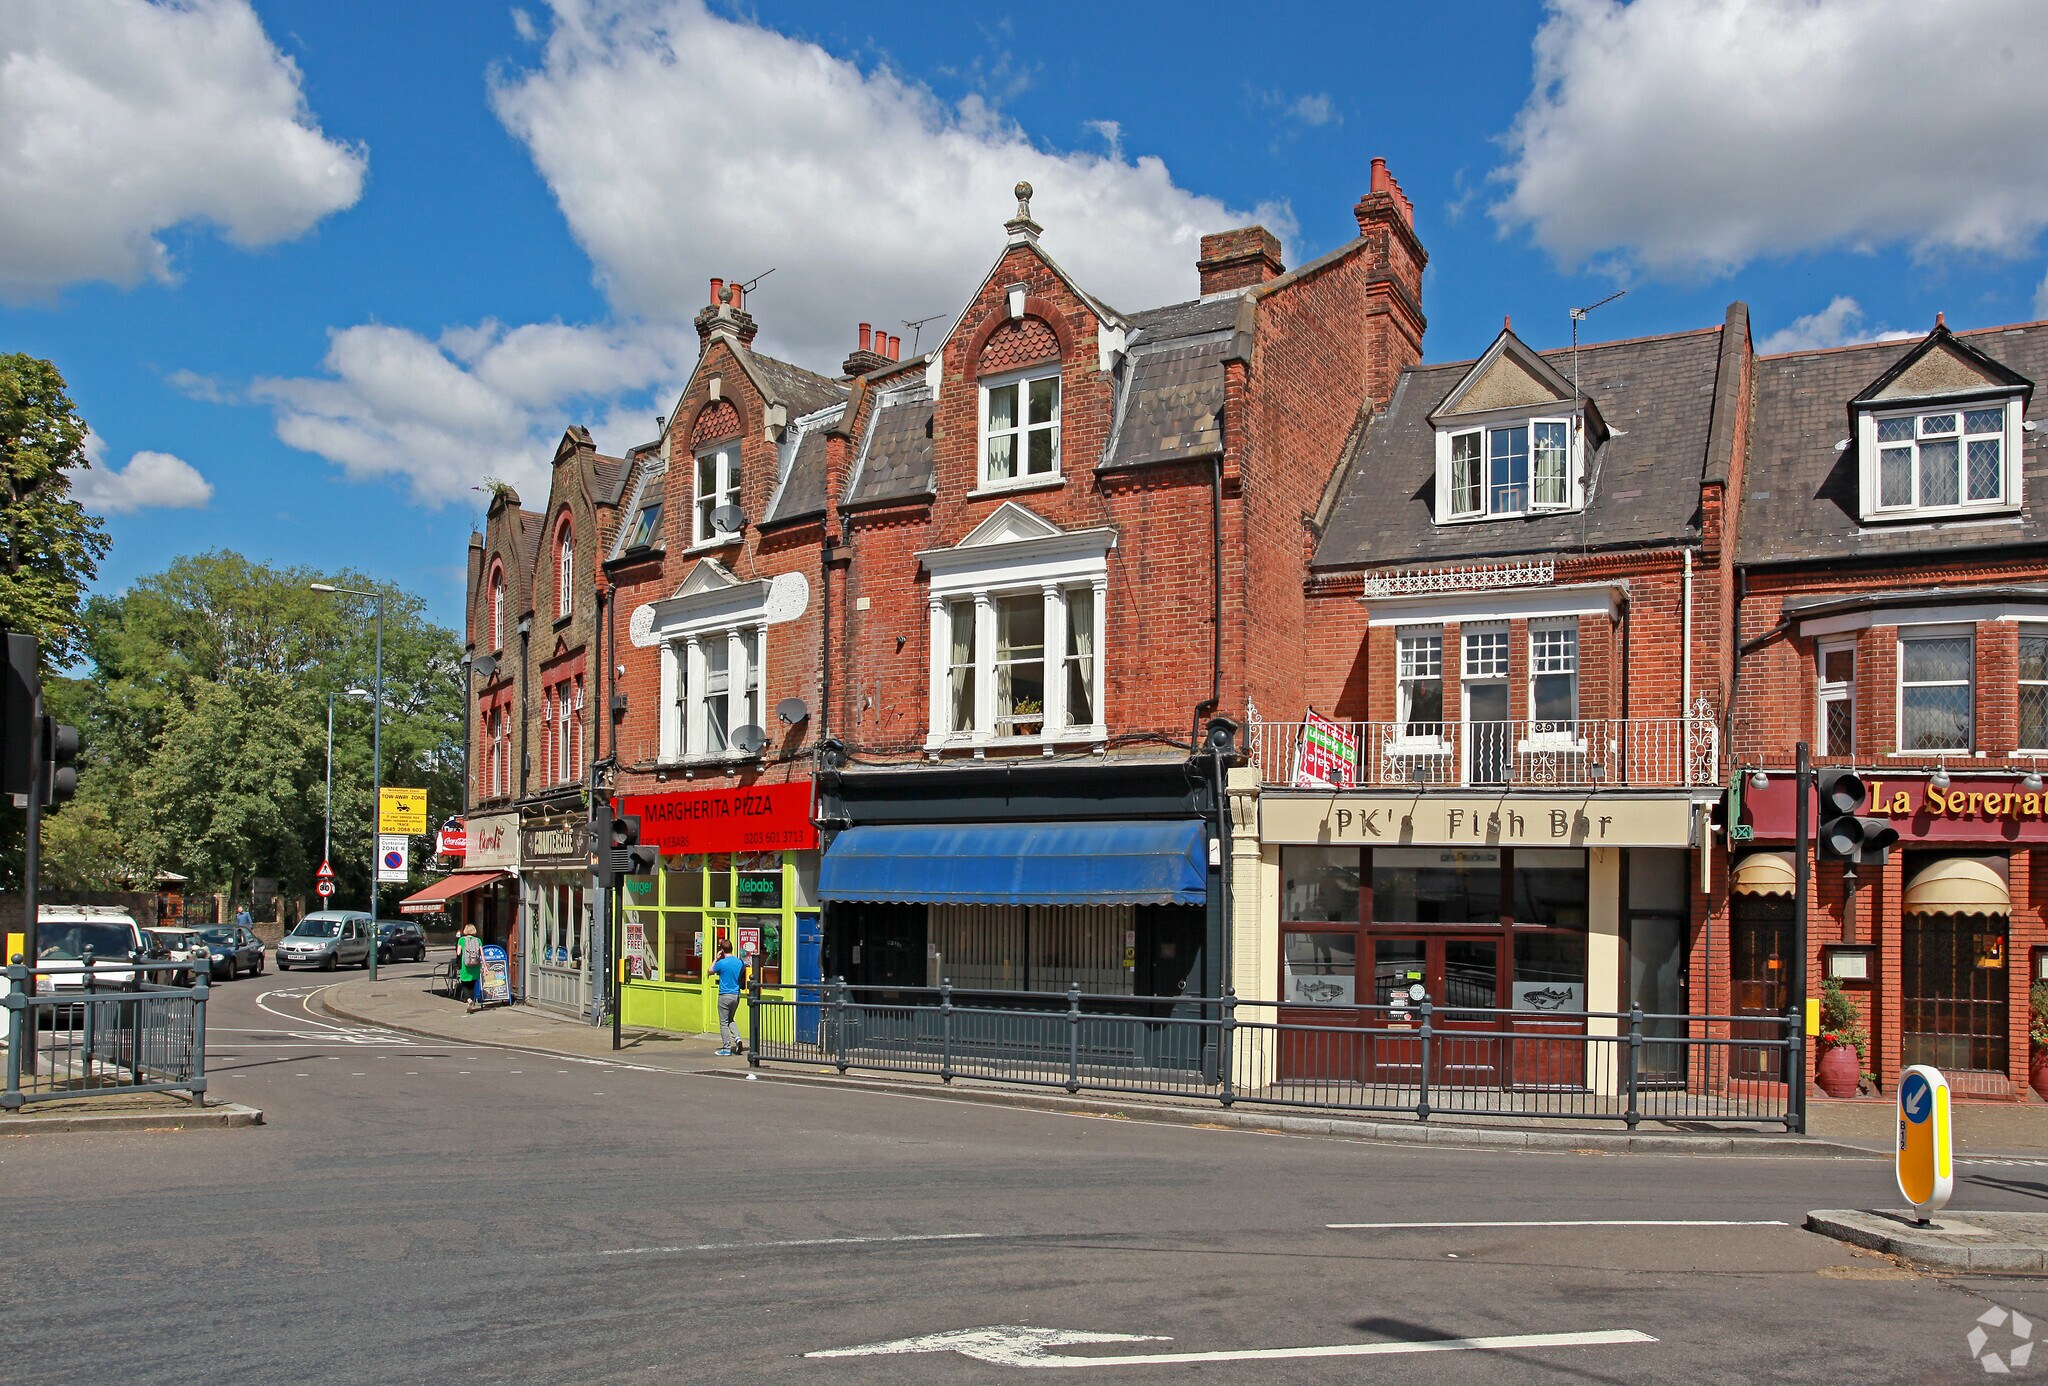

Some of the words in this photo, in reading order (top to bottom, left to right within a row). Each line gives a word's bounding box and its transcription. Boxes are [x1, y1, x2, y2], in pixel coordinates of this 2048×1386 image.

[1870, 781, 1911, 814] La
[645, 799, 730, 822] MARGHERITA
[734, 796, 772, 816] PIZZA
[664, 836, 689, 848] KEBABS
[744, 832, 763, 844] 0203
[766, 831, 780, 843] 601
[784, 830, 803, 843] 3713
[628, 880, 652, 896] Burger
[739, 878, 774, 893] Kebabs
[627, 941, 642, 949] FREE!
